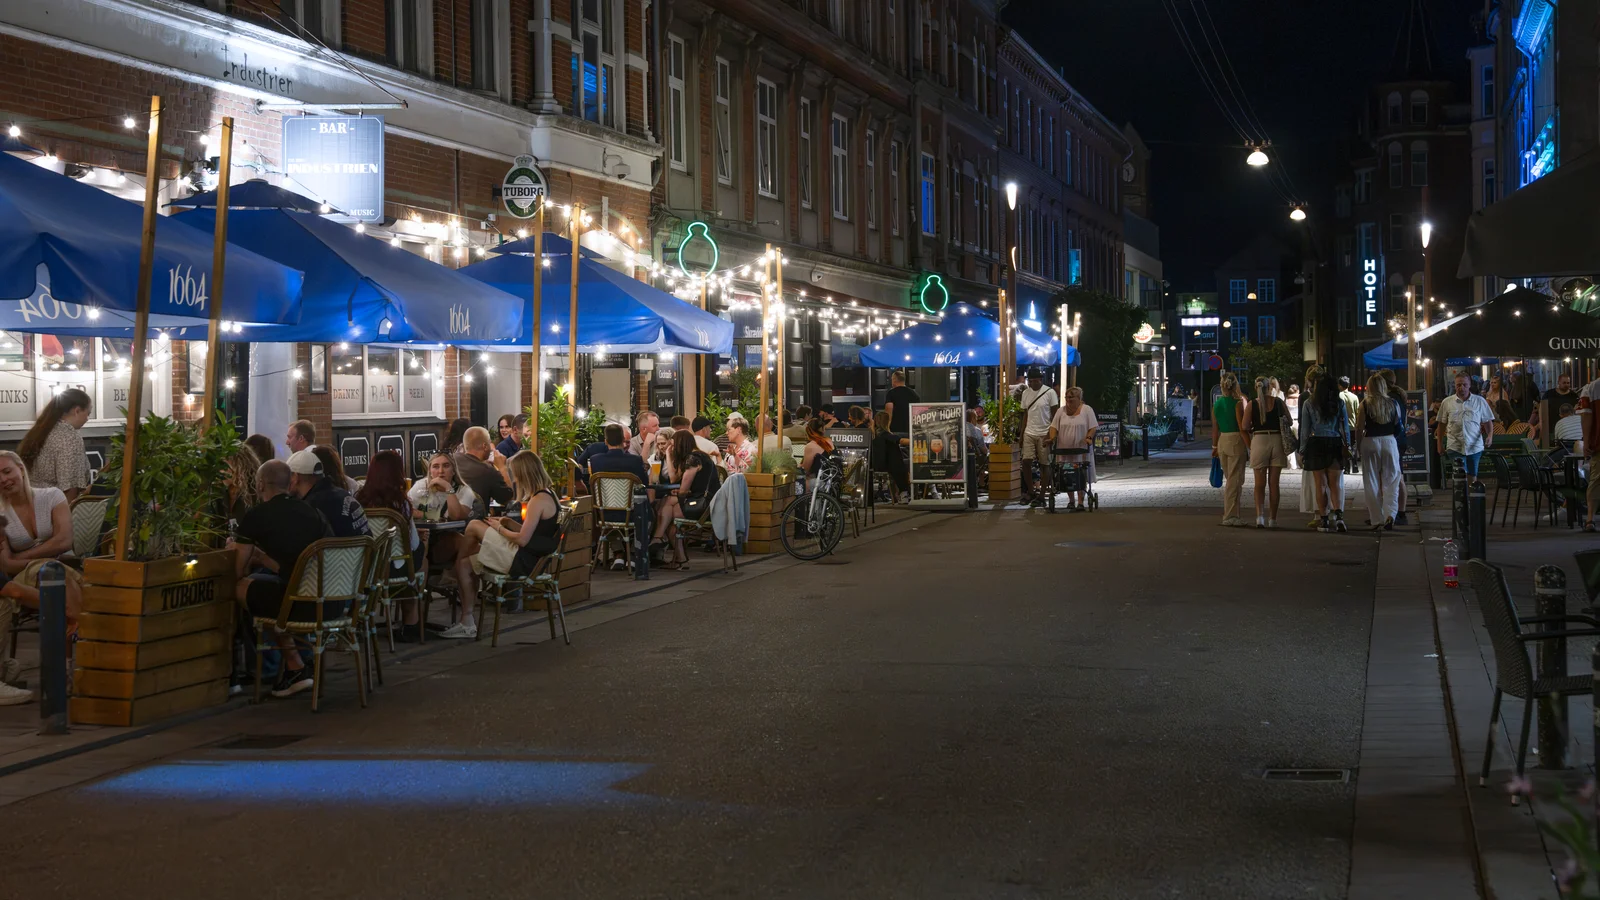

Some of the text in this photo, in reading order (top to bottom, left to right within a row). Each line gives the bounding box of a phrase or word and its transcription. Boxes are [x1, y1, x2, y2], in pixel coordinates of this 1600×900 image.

[221, 44, 294, 95] Industrien
[319, 122, 347, 133] BAR
[287, 163, 378, 174] INDUSTRIEN
[504, 187, 544, 197] TUBORG
[350, 208, 375, 216] MUSIC
[168, 263, 209, 311] 1664
[1363, 259, 1377, 326] HOTEL
[449, 303, 471, 336] 1664
[933, 352, 961, 365] 1664
[114, 388, 130, 402] BE
[333, 388, 360, 400] DRINKS
[371, 385, 395, 402] BAR
[912, 407, 962, 425] HAPPY HOUR
[830, 434, 863, 443] TUBORG
[344, 455, 367, 466] DRINKS
[417, 449, 431, 461] BEE
[160, 579, 214, 611] TUBORG
